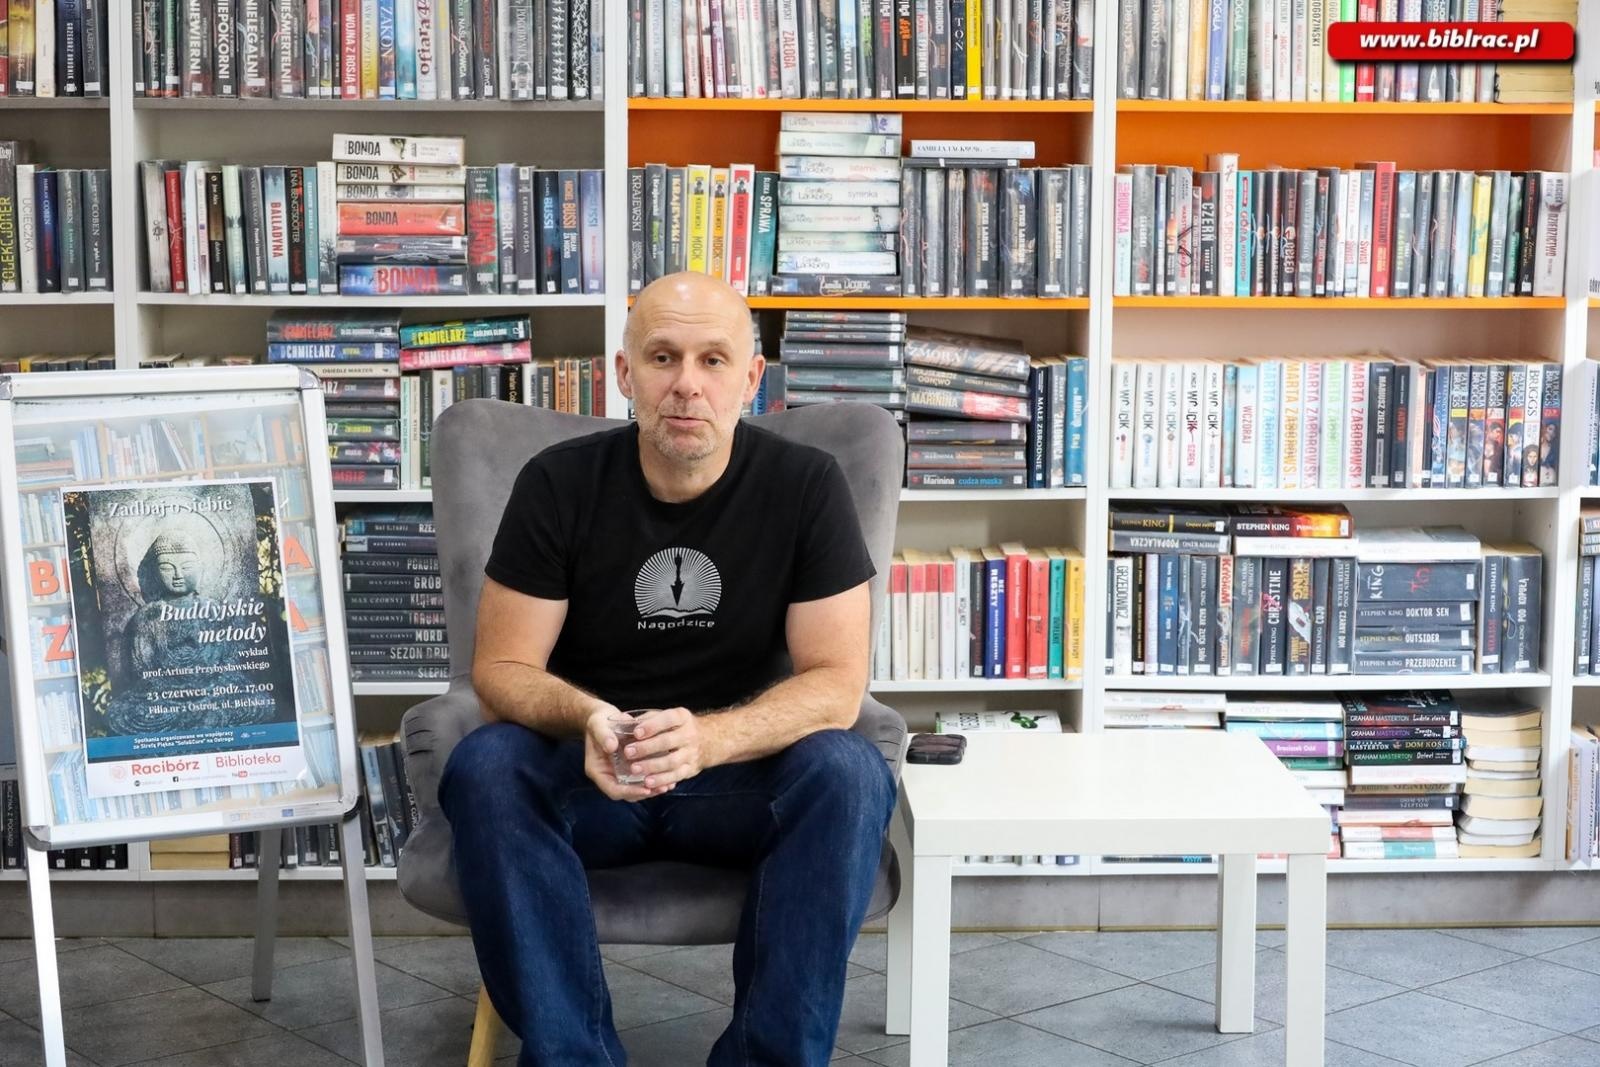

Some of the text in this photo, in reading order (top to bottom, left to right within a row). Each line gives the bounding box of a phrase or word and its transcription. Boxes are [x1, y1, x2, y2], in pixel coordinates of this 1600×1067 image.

[189, 0, 203, 75] NIEWIERNI
[345, 13, 357, 44] WOJNA
[419, 19, 434, 76] ofiara
[782, 30, 797, 69] ZAŁOGA
[807, 31, 816, 66] WIARA
[343, 55, 356, 84] ROSJĄ
[347, 140, 381, 157] BONDA
[346, 165, 379, 181] BONDA
[346, 185, 379, 199] BONDA
[631, 174, 642, 231] KRAJEWSKI
[651, 178, 661, 216] Krajewski
[43, 200, 51, 225] COBEN
[92, 203, 100, 235] COBEN
[366, 211, 398, 226] BONDA
[543, 197, 554, 229] BUSSI
[562, 203, 577, 229] BUSSI
[670, 177, 682, 243] KRAJEWSKI
[758, 195, 773, 233] SPRAWA
[1117, 192, 1131, 233] RUDNICKA
[1200, 202, 1215, 241] CZERŃ
[22, 197, 34, 253] UCIECZKA
[271, 202, 284, 258] BALLADYNA
[1222, 189, 1234, 268] ERICA SPINDLER
[1239, 210, 1250, 243] GÓRA
[1545, 212, 1559, 257] DZIEDZICTWO
[522, 230, 530, 254] FORSA
[692, 236, 704, 260] MOCK
[712, 236, 724, 259] MOCK
[1491, 239, 1503, 263] CISZY
[1284, 242, 1295, 273] OBŁĘD
[286, 344, 336, 359] CHMIELARZ
[508, 372, 518, 390] Harlan
[1285, 363, 1299, 403] MARTA
[1307, 363, 1320, 402] MARTA
[1351, 363, 1364, 403] MARTA
[1495, 371, 1504, 406] PATRICIA
[1527, 370, 1540, 416] BRIGGS
[1544, 370, 1553, 406] BRIGGS
[1551, 370, 1560, 405] PATRICIA
[1377, 376, 1386, 434] MARIUSZ ZIELKE
[1035, 396, 1045, 470] MAŁE ZBRODNIE
[1241, 405, 1252, 444] WCZORAJ
[923, 476, 1002, 485] Marinina cudza maska
[108, 497, 232, 518] Zadbaj o siebie
[419, 524, 435, 533] RZE
[1142, 518, 1165, 528] KING
[1236, 522, 1290, 531] STEPHEN KING
[1130, 537, 1179, 548] PODPALACZKA
[414, 575, 442, 589] GRÓB
[990, 568, 999, 606] RESZTY
[1199, 562, 1207, 588] STEPHEN
[1247, 562, 1255, 587] STEPHEN
[1292, 562, 1304, 600] KING
[1342, 562, 1350, 590] STEPHEN
[1367, 565, 1384, 599] KING
[1115, 565, 1129, 619] GRZĘDOWICZ
[1266, 570, 1281, 624] CHRISTINE
[1489, 594, 1497, 613] KING
[160, 598, 264, 622] Buddyjskie
[1198, 608, 1206, 626] BAZAR
[1315, 605, 1325, 624] CUJO
[1405, 608, 1433, 617] DOKTOR
[1436, 608, 1450, 617] SEN
[1517, 608, 1527, 623] POD
[199, 621, 267, 643] metody
[415, 630, 443, 642] MORD
[637, 618, 715, 630] Nagodzice
[1337, 610, 1347, 649] CZARNY DOM
[1404, 633, 1440, 643] OUTSIDER
[238, 647, 268, 658] wykład
[390, 647, 423, 659] SEZON
[1405, 658, 1457, 668] PRZEBUDZENIE
[165, 666, 194, 676] Artura
[147, 692, 159, 701] 23
[245, 682, 274, 693] 17.00
[149, 706, 169, 715] Filia
[234, 698, 266, 709] Bielska
[133, 737, 159, 746] Spotkania
[131, 759, 200, 776] Racibórz
[216, 753, 281, 768] Biblioteka
